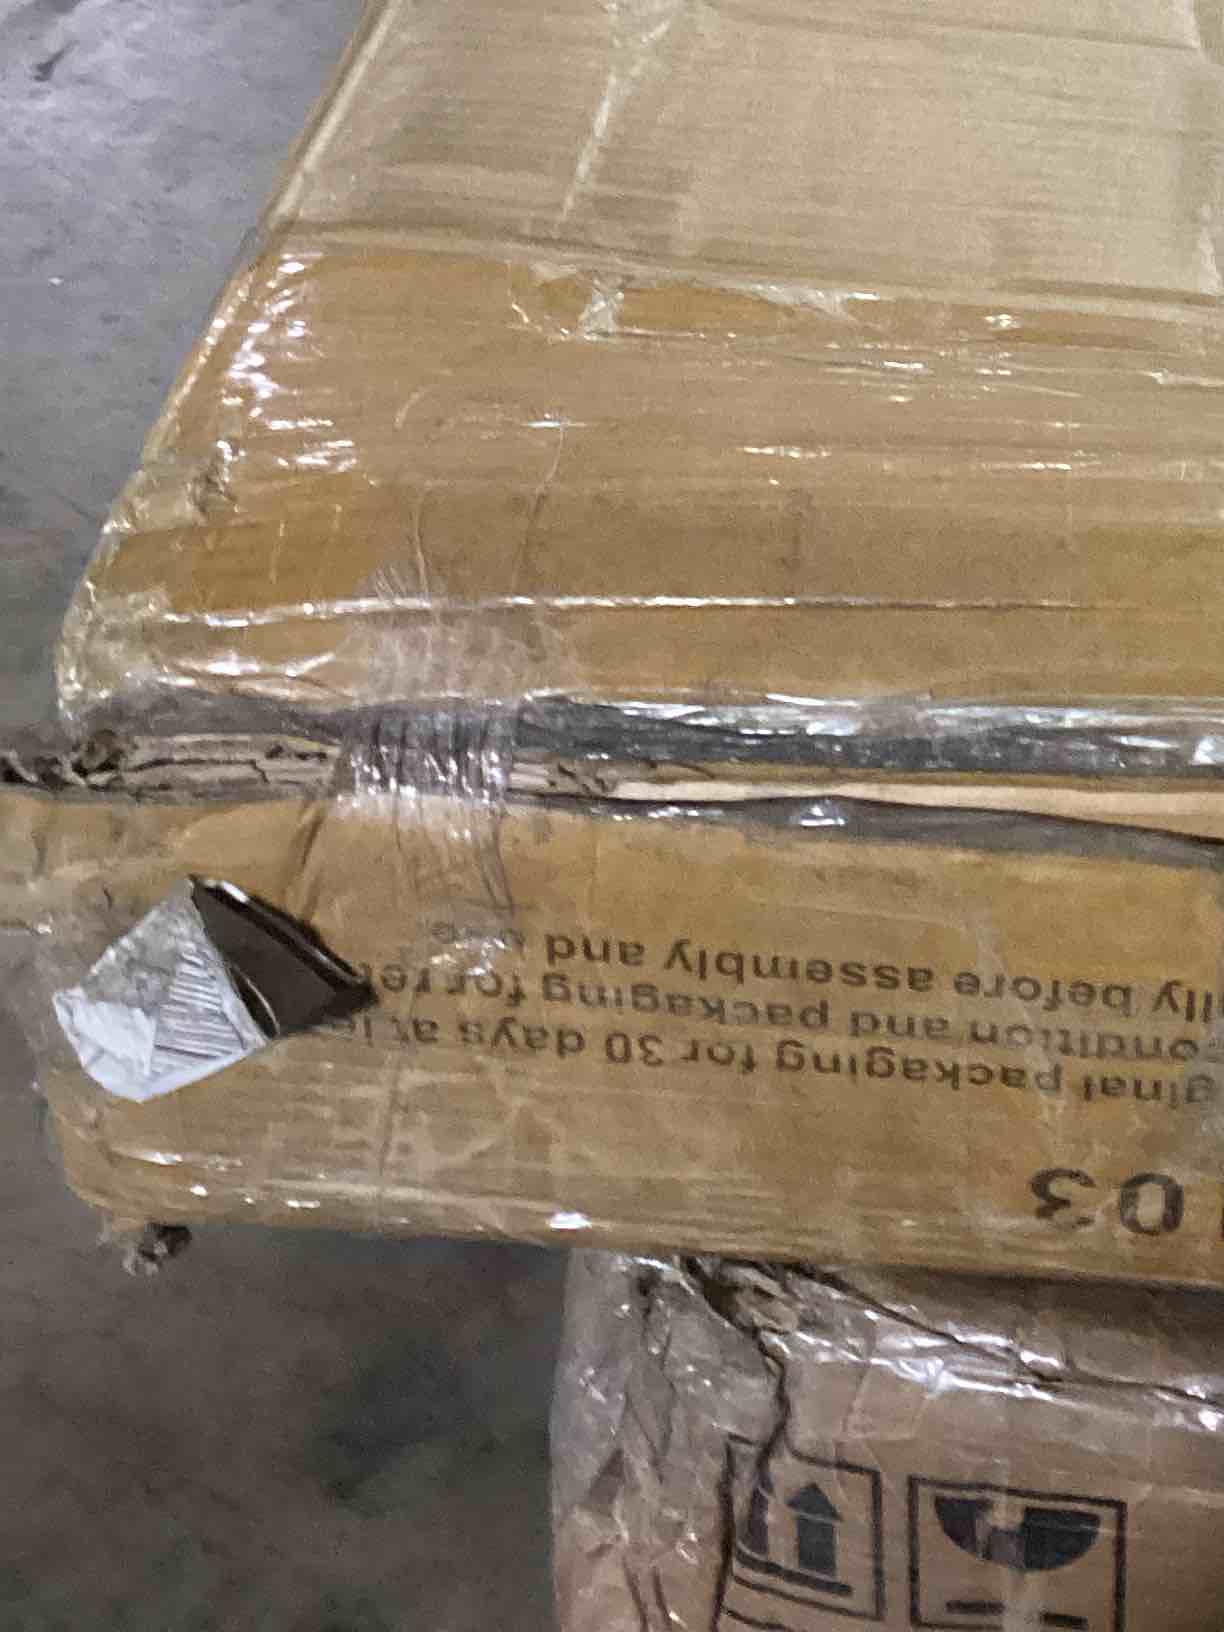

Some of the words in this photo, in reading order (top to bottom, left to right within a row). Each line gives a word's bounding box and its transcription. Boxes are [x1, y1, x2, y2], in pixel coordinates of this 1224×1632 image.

[545, 934, 645, 971] and
[662, 938, 934, 995] assembly
[445, 967, 526, 1008] for
[541, 971, 830, 1033] packaging
[953, 969, 1134, 1018] before
[457, 1016, 586, 1060] days
[604, 1031, 664, 1068] 30
[850, 1009, 951, 1047] and
[970, 1018, 1224, 1063] ondition
[679, 1037, 757, 1077] for
[777, 1039, 1063, 1100] packaging
